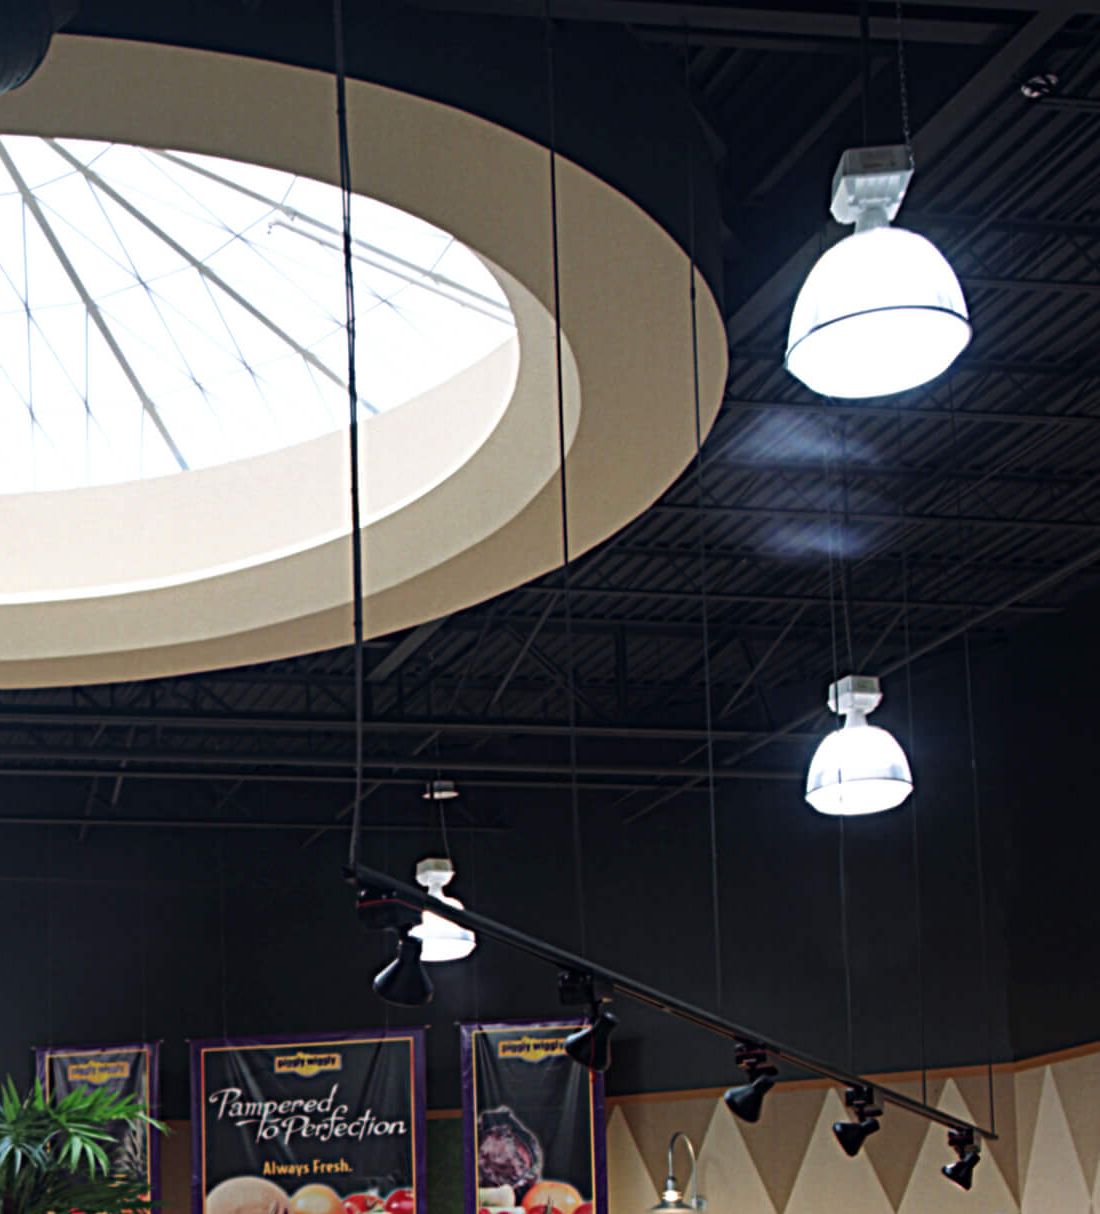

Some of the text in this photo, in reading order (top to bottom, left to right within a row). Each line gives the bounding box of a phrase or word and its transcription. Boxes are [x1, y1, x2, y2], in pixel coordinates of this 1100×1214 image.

[208, 1082, 339, 1121] Pampered
[235, 1104, 407, 1145] To Perfection
[263, 1158, 353, 1176] Always Fresh.
